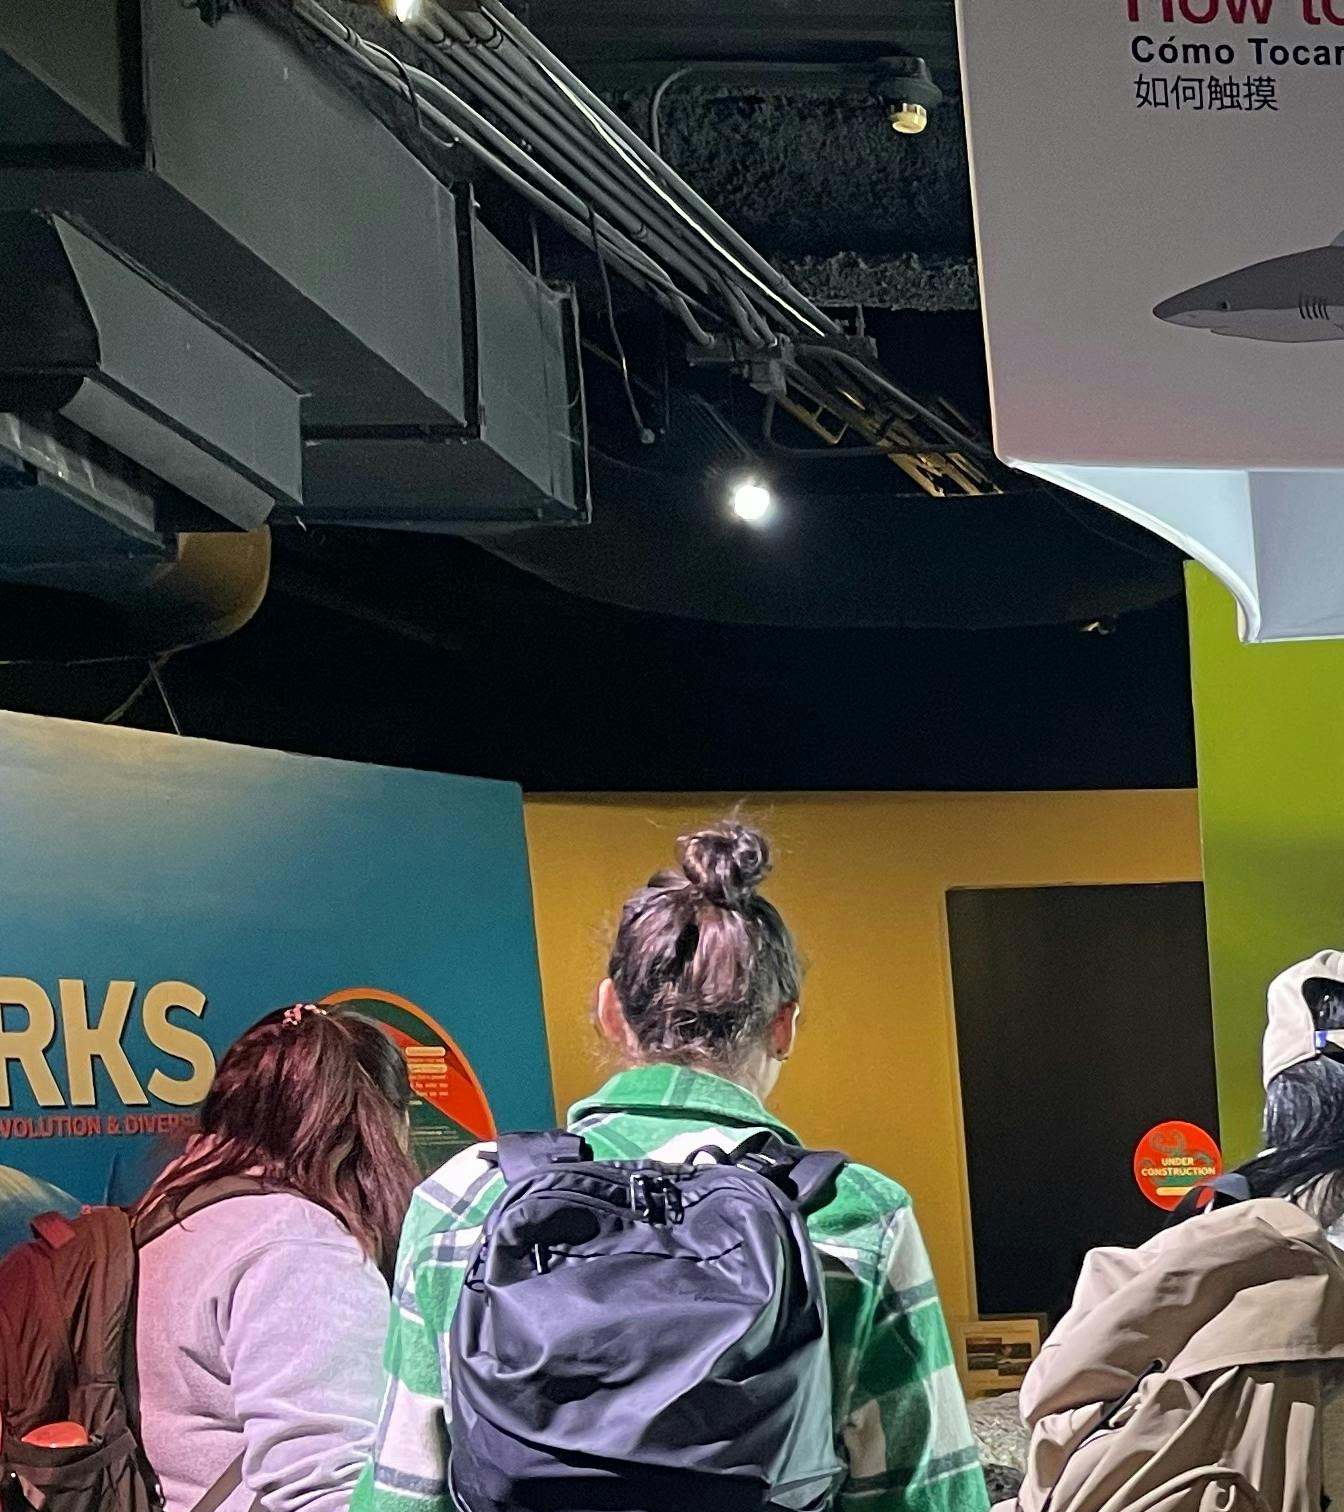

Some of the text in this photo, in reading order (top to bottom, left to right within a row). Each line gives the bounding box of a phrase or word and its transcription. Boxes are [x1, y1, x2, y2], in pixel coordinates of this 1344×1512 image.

[1131, 35, 1235, 64] Cómo
[1133, 73, 1280, 111] 如何触摸
[0, 976, 216, 1107] RKS
[107, 1115, 121, 1134] &
[1141, 1167, 1216, 1177] CONSTRUCTION
[1161, 1157, 1194, 1166] UNDER
